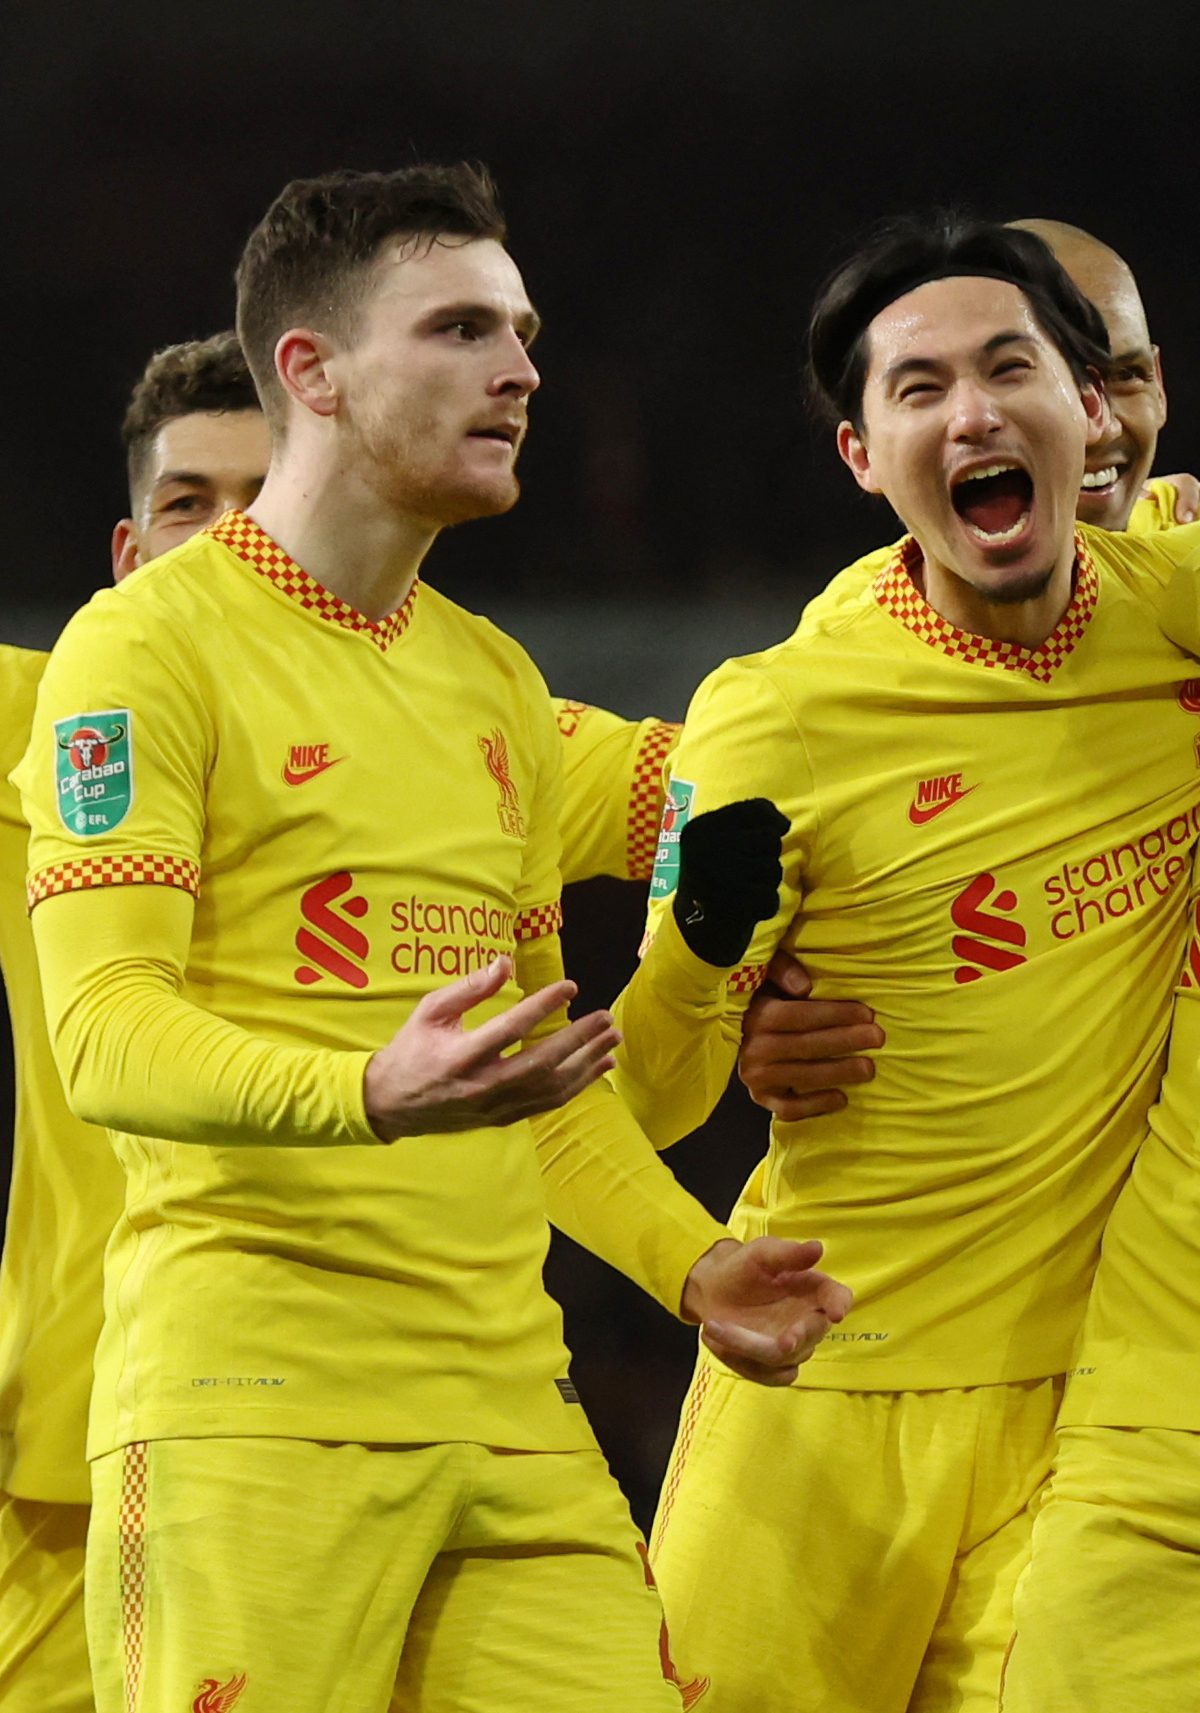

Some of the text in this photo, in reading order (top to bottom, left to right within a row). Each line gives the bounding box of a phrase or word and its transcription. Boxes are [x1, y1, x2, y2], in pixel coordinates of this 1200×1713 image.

[289, 744, 329, 768] NIKE
[60, 760, 125, 795] Carabao
[74, 783, 106, 803] Cup
[917, 773, 962, 805] NIKE
[88, 814, 109, 826] EFL
[1044, 806, 1200, 906] standar
[1051, 856, 1186, 940] charte
[391, 936, 515, 981] charte
